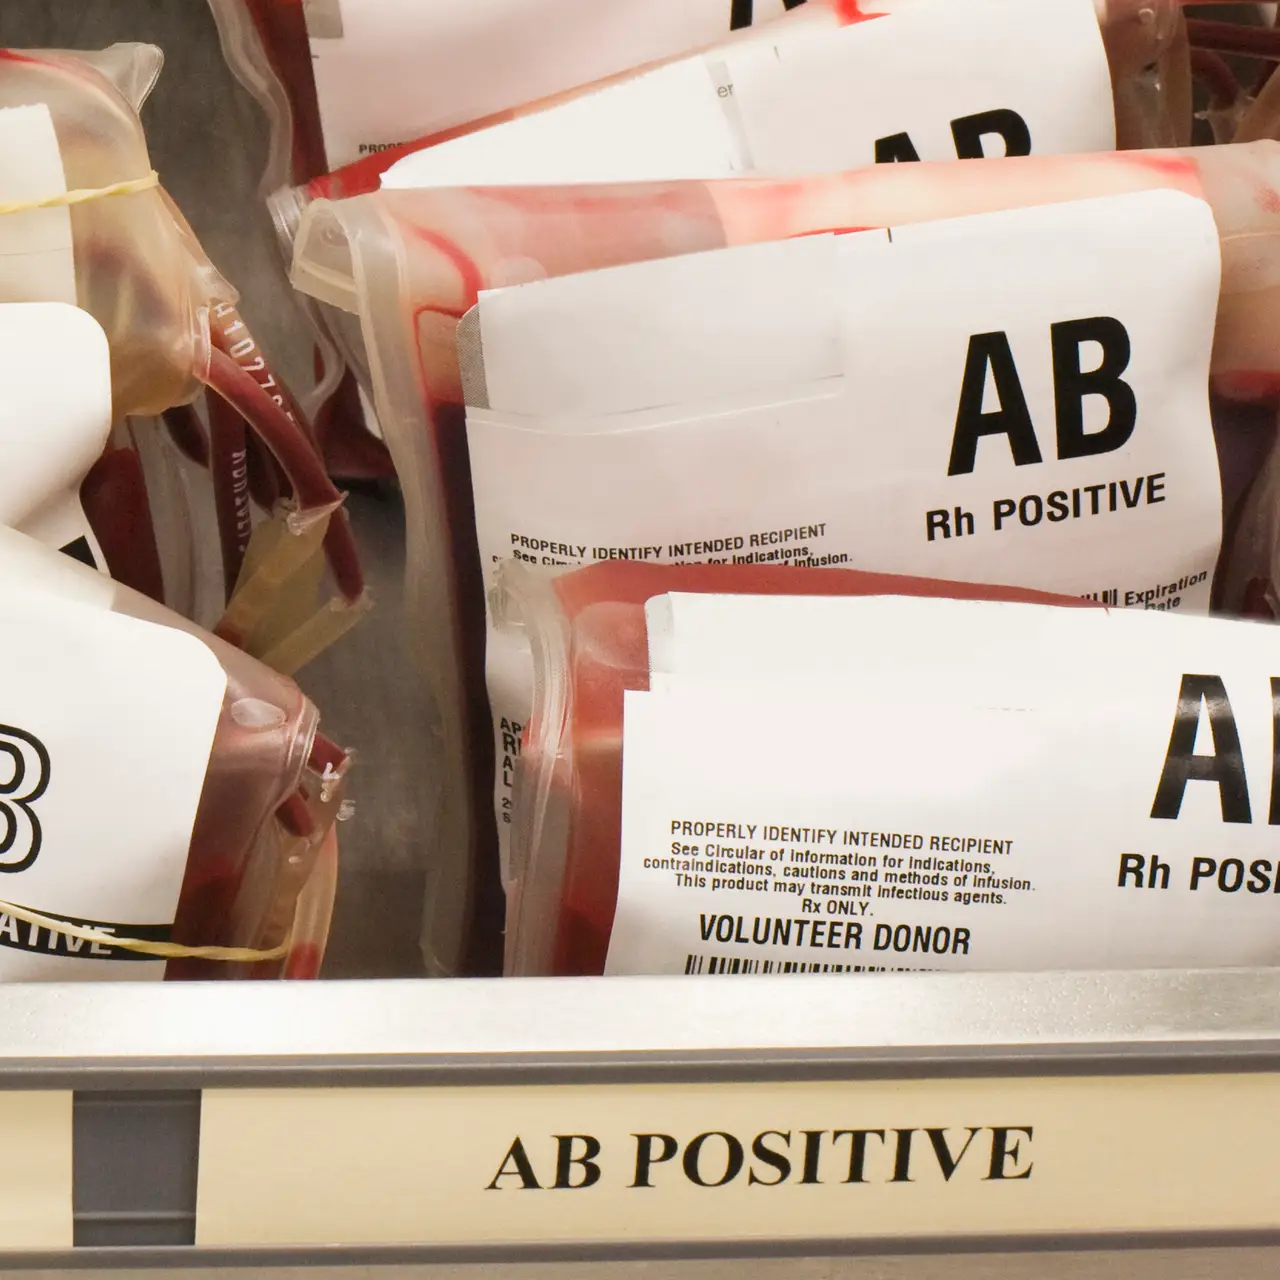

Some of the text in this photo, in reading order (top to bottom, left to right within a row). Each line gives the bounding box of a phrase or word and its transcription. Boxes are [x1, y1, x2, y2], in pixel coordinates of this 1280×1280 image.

[948, 317, 1136, 476] AB
[926, 472, 1166, 541] Rh POSITIVE
[511, 523, 826, 563] PROPERLY IDENTIFY INTENDED RECIPIENT
[1124, 571, 1207, 606] Expiration
[671, 821, 1013, 855] PROPERLY IDENTIFY INTENDED RECIPIENT
[671, 842, 699, 856] See
[705, 844, 765, 860] Circular
[770, 848, 784, 861] of
[883, 855, 904, 868] for
[644, 858, 776, 877] contraindications,
[783, 866, 846, 880] cautions
[851, 869, 878, 882] and
[884, 871, 948, 886] methods
[954, 874, 968, 887] of
[1117, 853, 1170, 889] Rh
[675, 873, 706, 888] This
[712, 877, 768, 891] product
[774, 882, 805, 896] may
[811, 882, 872, 897] transmit
[954, 892, 1006, 905] agents.
[802, 898, 873, 916] Rx ONLY.
[700, 914, 970, 955] VOLUNTEER DONOR
[485, 1126, 1033, 1190] AB POSITIVE
